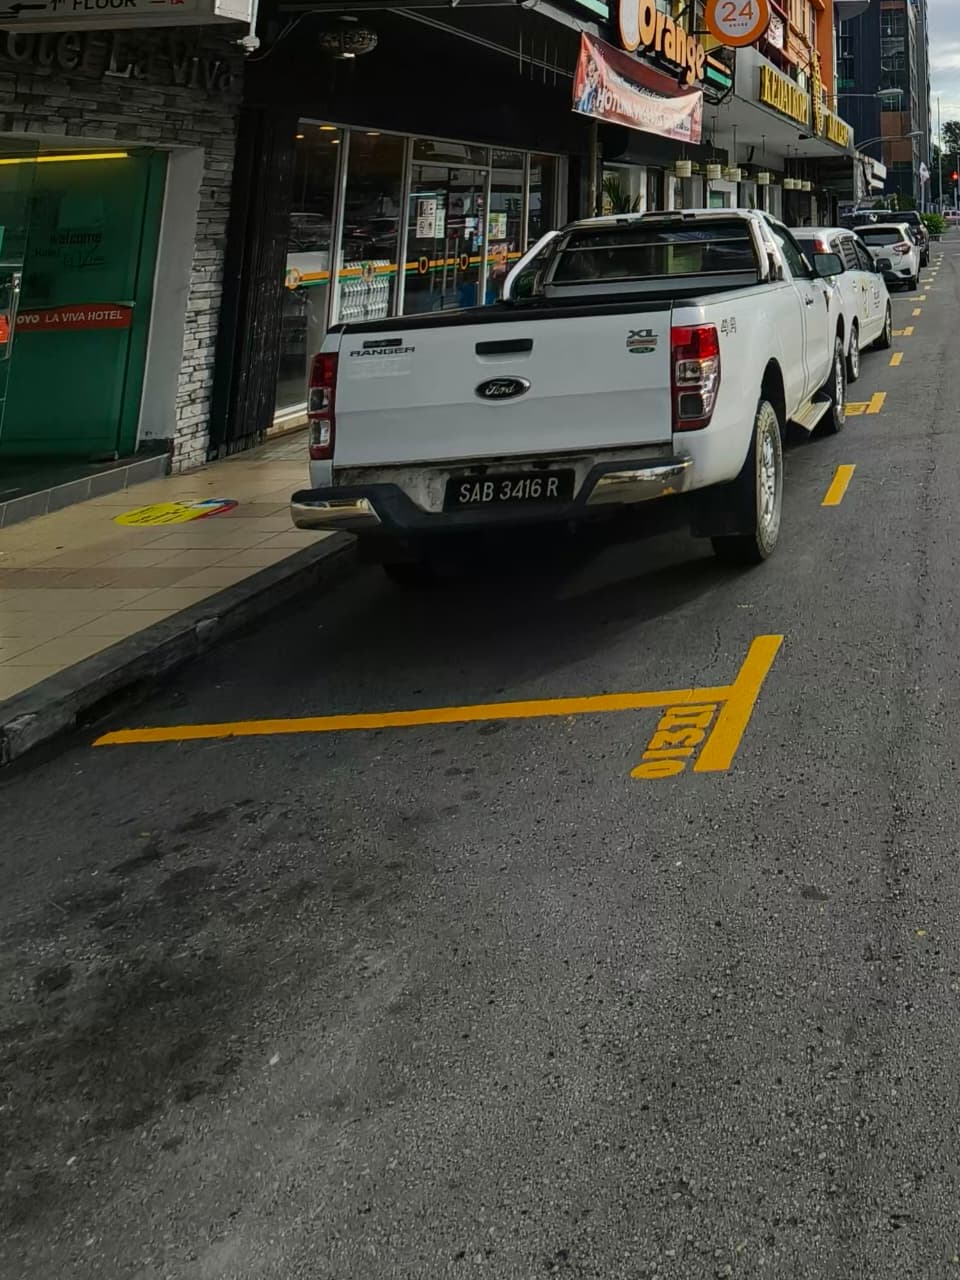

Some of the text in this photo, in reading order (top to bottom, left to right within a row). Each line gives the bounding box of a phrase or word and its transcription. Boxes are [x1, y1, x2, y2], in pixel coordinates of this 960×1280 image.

[721, 0, 754, 23] 24
[17, 310, 123, 324] OYO LA VIVA HOTEL
[350, 346, 415, 357] RANGER
[485, 383, 516, 395] Ford
[459, 477, 559, 502] SAB 3416 R
